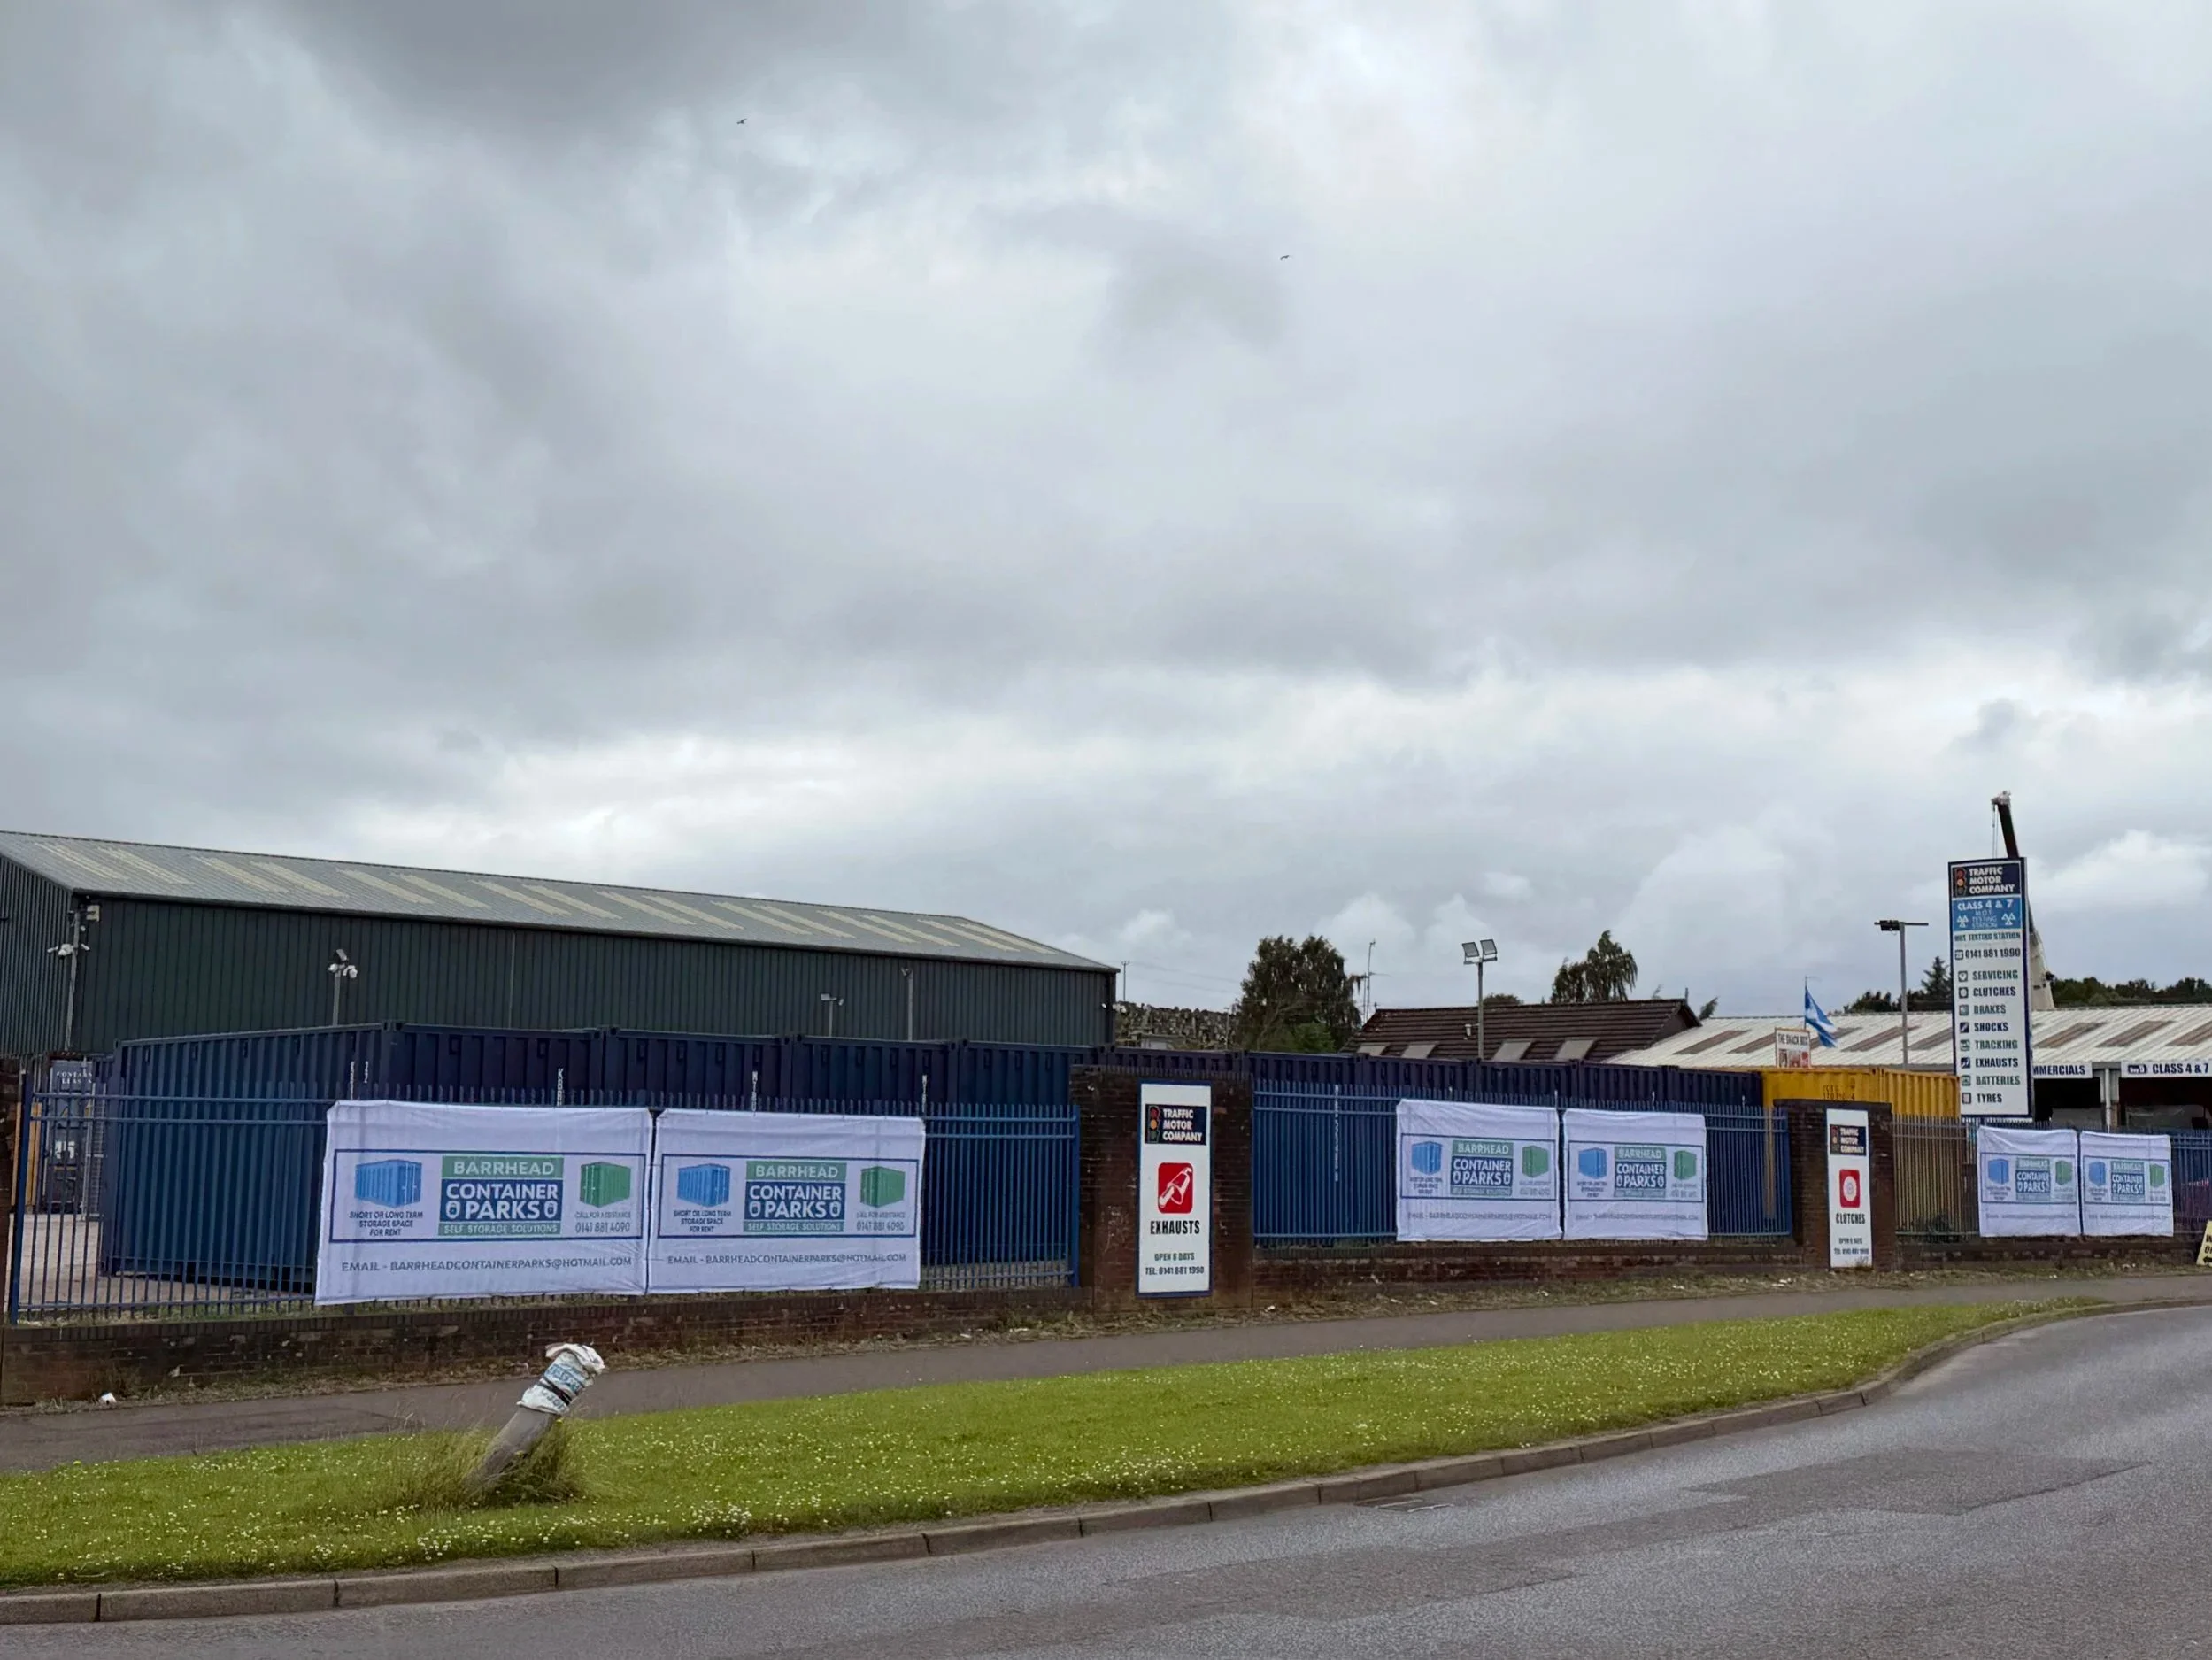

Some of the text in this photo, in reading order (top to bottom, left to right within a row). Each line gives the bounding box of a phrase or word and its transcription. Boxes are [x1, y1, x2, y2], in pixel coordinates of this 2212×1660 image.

[1969, 867, 2003, 876] TRAFFIC
[1969, 876, 2001, 885] MOTOR
[1969, 884, 2015, 894] COMPANY
[1957, 901, 1983, 911] CLASS
[2007, 899, 2014, 908] 7
[1965, 947, 2021, 959] 0141 881 1990
[1972, 970, 2018, 980] SERVICING
[1973, 987, 2016, 997] CLUTCHES
[1974, 1005, 2006, 1015] BRAKES
[1974, 1022, 2008, 1032] SHOCKS
[1975, 1039, 2018, 1050] TRACKING
[1975, 1057, 2018, 1068] EXHAUSTS
[2153, 1063, 2209, 1074] CLASS 4 & 7
[1976, 1076, 2021, 1085] BATTERIES
[1977, 1094, 2003, 1104] TYRES
[1163, 1108, 1194, 1119] TRAFFIC
[1163, 1120, 1192, 1131] MOTOR
[1163, 1131, 1203, 1142] COMPANY
[1840, 1127, 1859, 1136] TRAFFIC
[1457, 1143, 1509, 1154] BARRHEAD
[1840, 1145, 1865, 1154] COMPANY
[1619, 1149, 1662, 1160] BARRHEAD
[453, 1160, 554, 1176] BARRHEAD
[1453, 1158, 1511, 1172] CONTAINER
[1616, 1163, 1665, 1175] CONTAINER
[756, 1165, 838, 1178] BARRHEAD
[2018, 1172, 2050, 1182] CONTAINER
[1462, 1170, 1502, 1185] PARKS
[1623, 1176, 1656, 1187] PARKS
[2112, 1174, 2143, 1184] CONTAINER
[446, 1183, 559, 1201] CONTAINER
[2023, 1181, 2045, 1193] PARKS
[2118, 1183, 2139, 1193] PARKS
[749, 1186, 842, 1201] CONTAINER
[466, 1201, 541, 1220] PARKS
[765, 1201, 828, 1218] PARKS
[1836, 1213, 1866, 1224] CLUTCHES
[444, 1224, 558, 1234] SELF STORAGE SOLUTIONS
[575, 1222, 631, 1233] 0141 881 4090
[1151, 1220, 1200, 1235] EXHAUSTS
[668, 1256, 698, 1265] EMAIL
[1154, 1252, 1195, 1262] OPEN 6 DAYS
[342, 1262, 380, 1272] EMAIL
[391, 1257, 632, 1271] BARRHEADCONTAINERPARKS@HOTMAIL.COM
